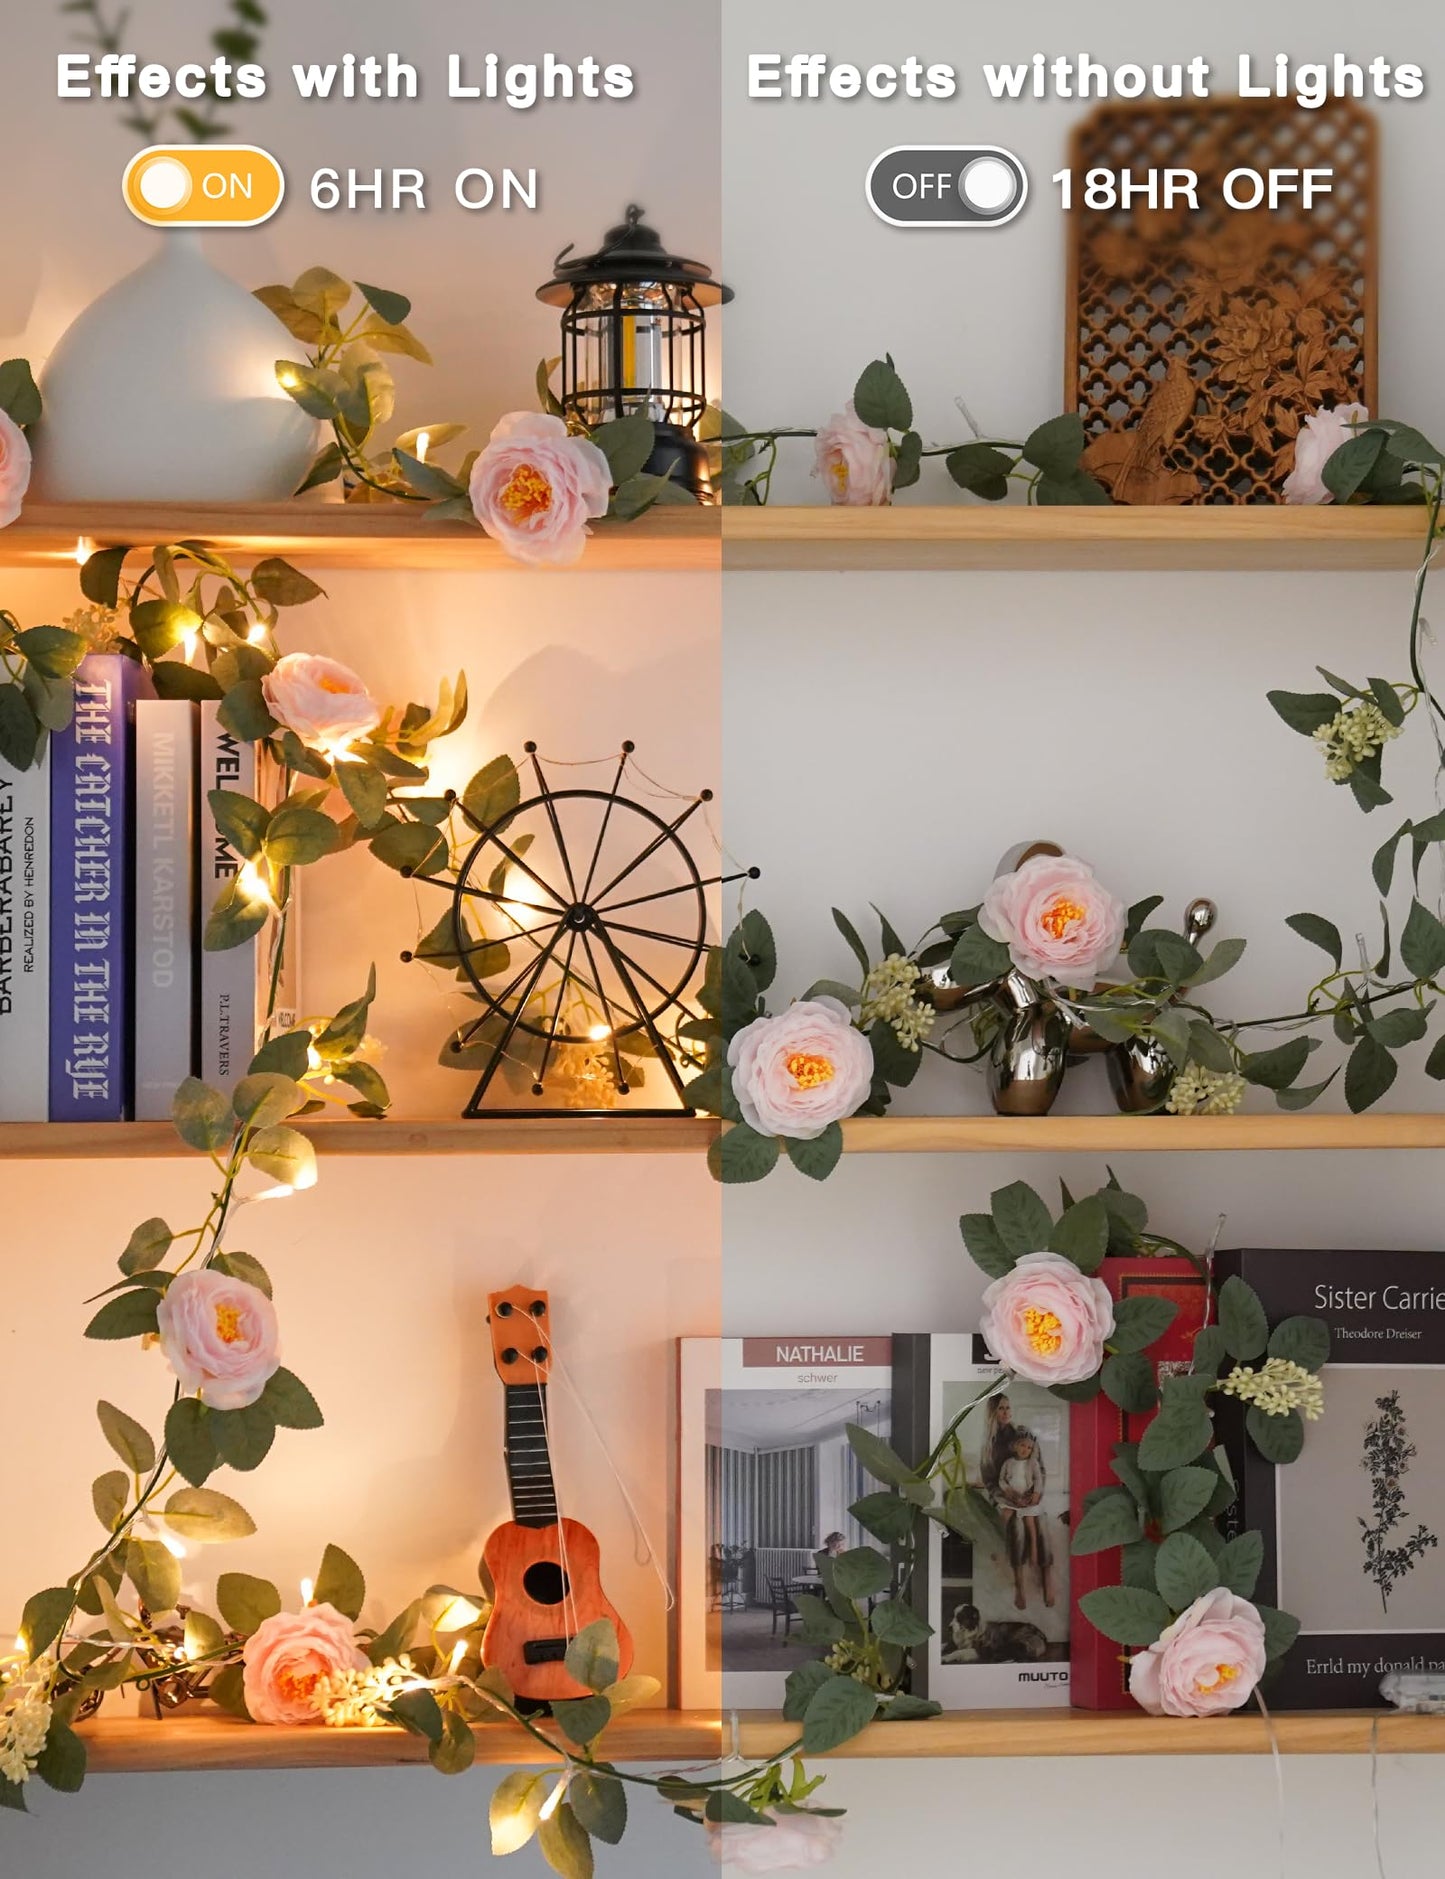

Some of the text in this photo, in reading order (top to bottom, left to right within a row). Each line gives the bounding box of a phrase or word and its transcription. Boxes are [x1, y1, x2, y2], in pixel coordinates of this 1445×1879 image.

[74, 679, 113, 745] THE
[74, 752, 112, 904] CATCHER
[214, 733, 240, 879] WELME
[153, 732, 175, 988] MIKKETL KARSTOD
[23, 816, 34, 973] REALIZED BY HENREDON
[72, 957, 110, 1025] THE
[218, 994, 230, 1076] P.L.TRAVERS
[1314, 1284, 1445, 1311] Sister Carrie
[776, 1345, 865, 1363] NATHALIE
[1334, 1326, 1422, 1340] Theodore Dreiser
[797, 1373, 838, 1383] schwer
[1018, 1671, 1068, 1682] MUUTO
[1306, 1658, 1344, 1674] Errld
[1347, 1662, 1371, 1678] my
